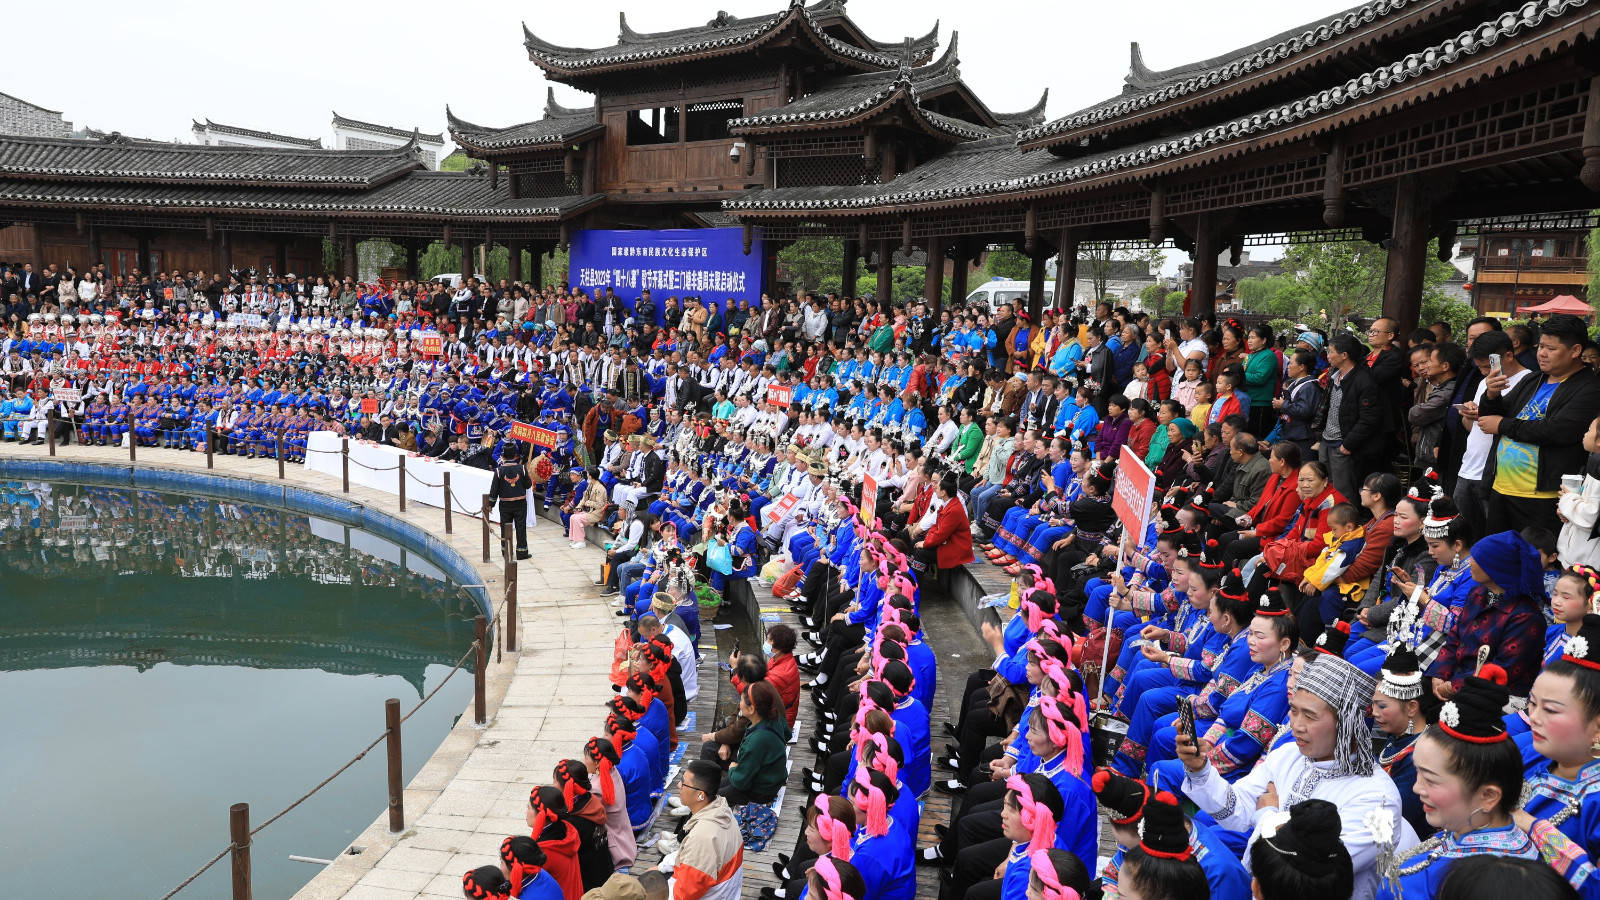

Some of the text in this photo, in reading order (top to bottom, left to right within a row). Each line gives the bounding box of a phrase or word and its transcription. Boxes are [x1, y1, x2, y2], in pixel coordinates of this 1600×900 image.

[611, 246, 708, 257] 国家级黔东南民族文化生态保护区
